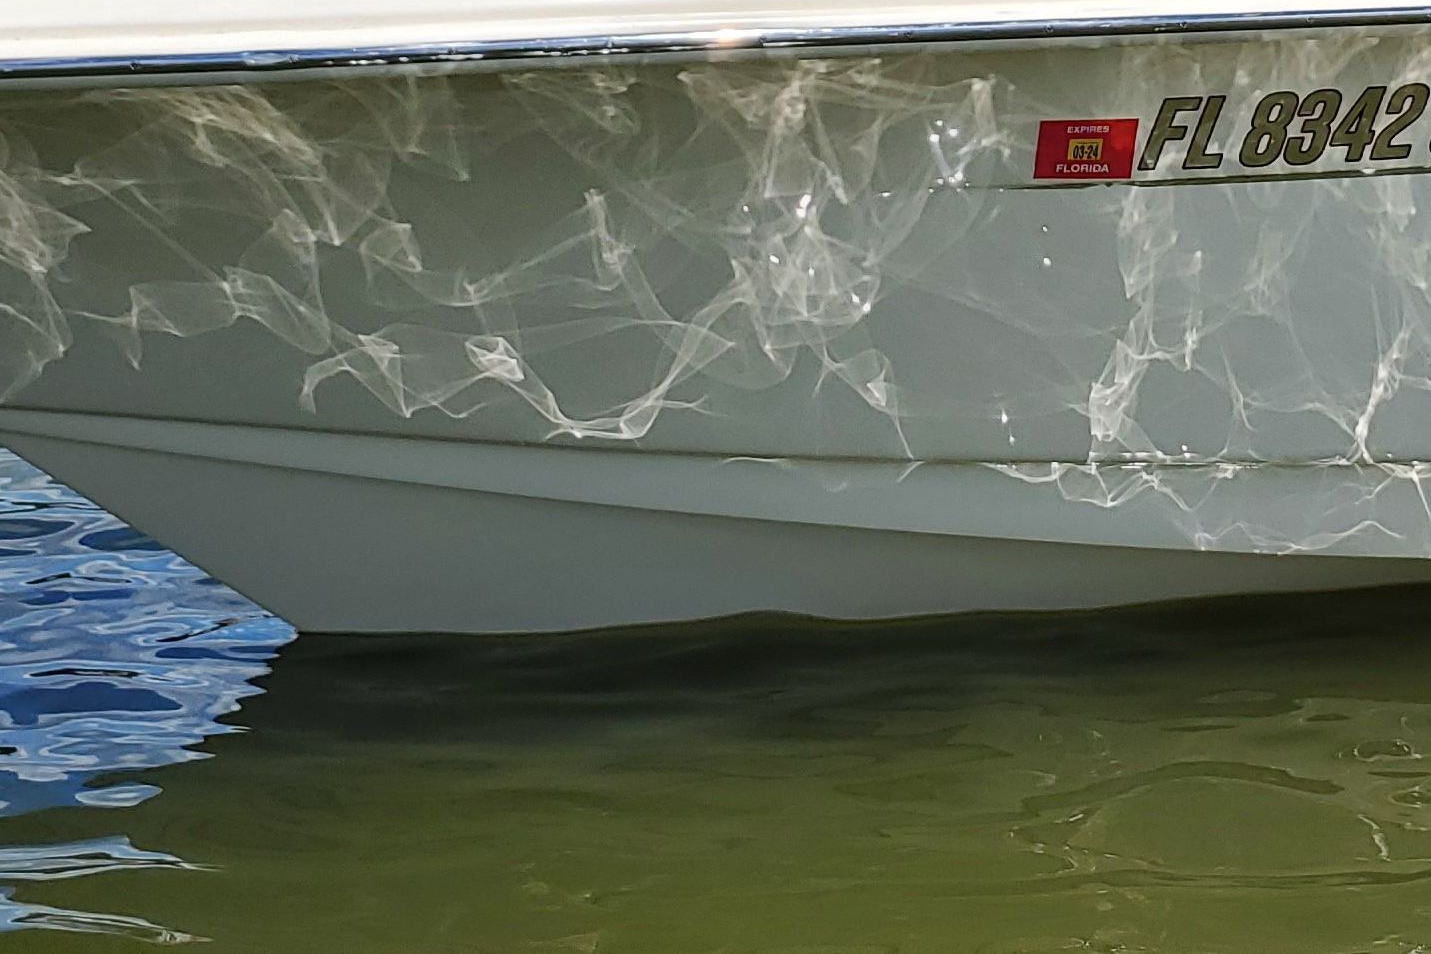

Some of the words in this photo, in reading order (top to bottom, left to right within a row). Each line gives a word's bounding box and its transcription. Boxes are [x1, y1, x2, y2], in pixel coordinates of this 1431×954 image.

[1067, 125, 1110, 134] EXPIRES
[1137, 94, 1227, 171] FL
[1238, 83, 1430, 169] 8342
[1056, 163, 1110, 174] FLORIDA
